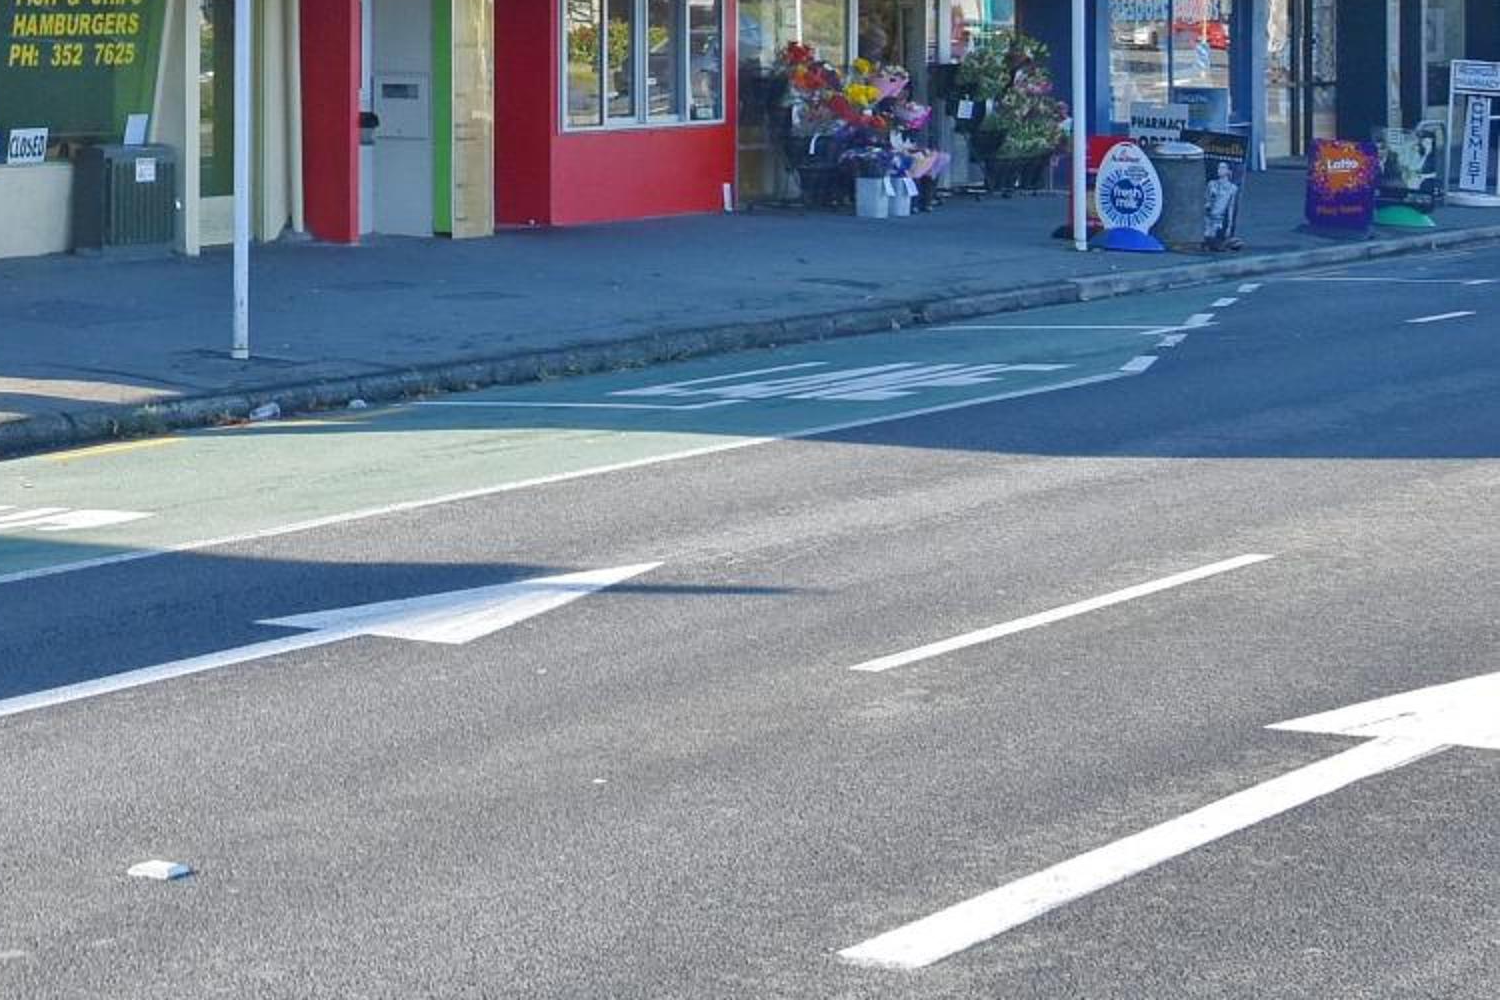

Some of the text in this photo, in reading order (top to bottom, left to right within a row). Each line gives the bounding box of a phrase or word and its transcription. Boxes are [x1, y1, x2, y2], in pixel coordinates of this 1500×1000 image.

[12, 13, 140, 37] HAMBURGERS
[8, 42, 136, 67] PH: 352 7625
[1131, 115, 1187, 131] PHARMACY
[9, 135, 45, 158] CLOSED
[1467, 101, 1485, 185] CHEMIST
[1327, 158, 1360, 170] Lotto
